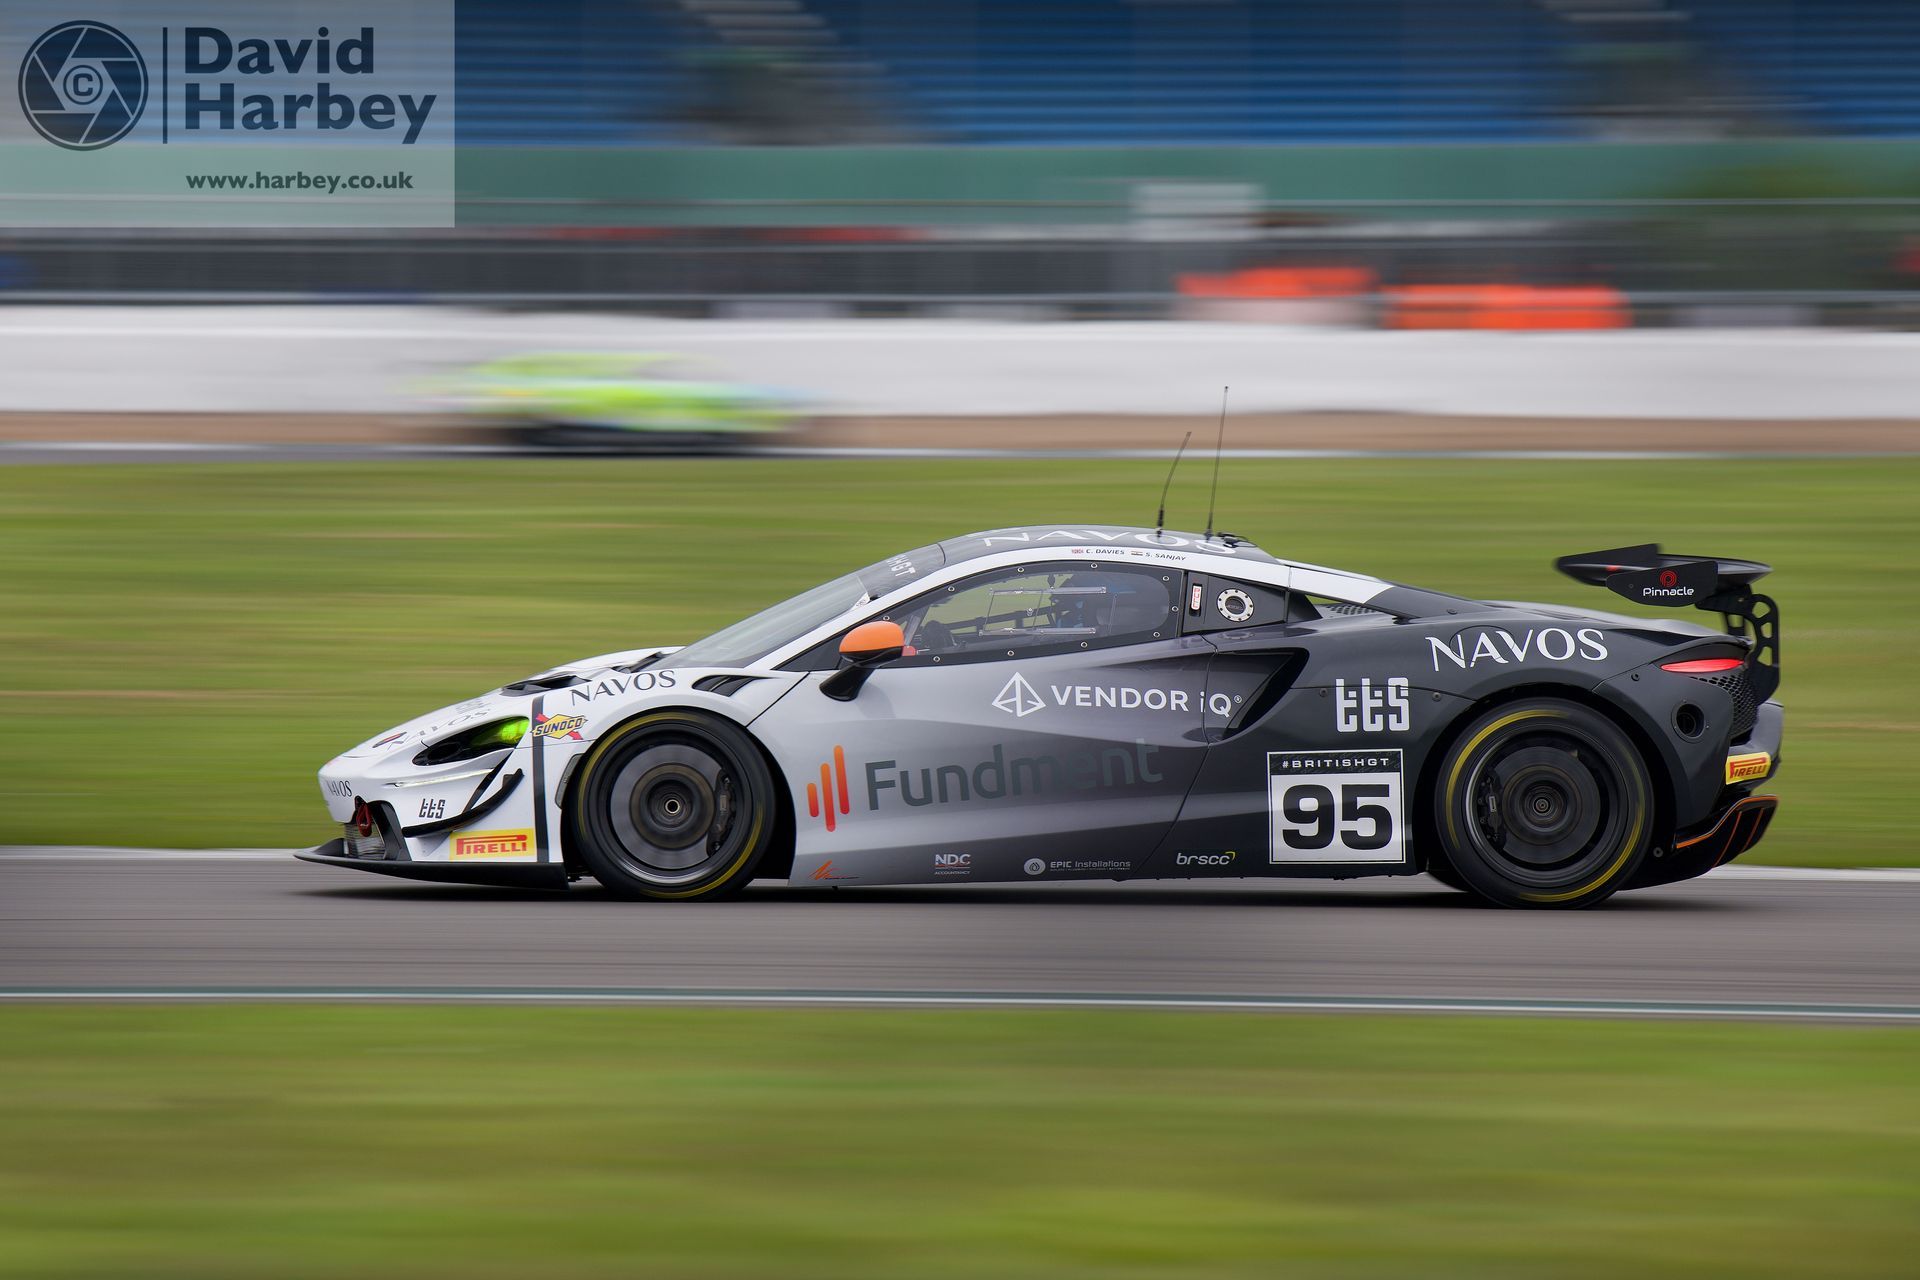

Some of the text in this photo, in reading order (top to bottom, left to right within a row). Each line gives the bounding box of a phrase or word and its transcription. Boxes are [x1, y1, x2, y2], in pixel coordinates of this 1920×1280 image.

[1155, 553, 1186, 561] SANJAY
[1643, 586, 1695, 597] Pinnacle
[1425, 628, 1608, 672] NAVOS
[570, 670, 677, 706] NAVOS
[1050, 685, 1189, 712] VENDOR
[534, 718, 585, 736] SUNOCO
[1282, 757, 1389, 768] #BRITISHGT
[1729, 757, 1767, 778] PIRELLI
[865, 738, 1163, 811] Fundment
[1282, 784, 1393, 850] 95
[456, 835, 528, 855] PIRELLI
[935, 853, 971, 865] NDC
[1075, 860, 1131, 868] Installations
[1176, 852, 1231, 866] brscc
